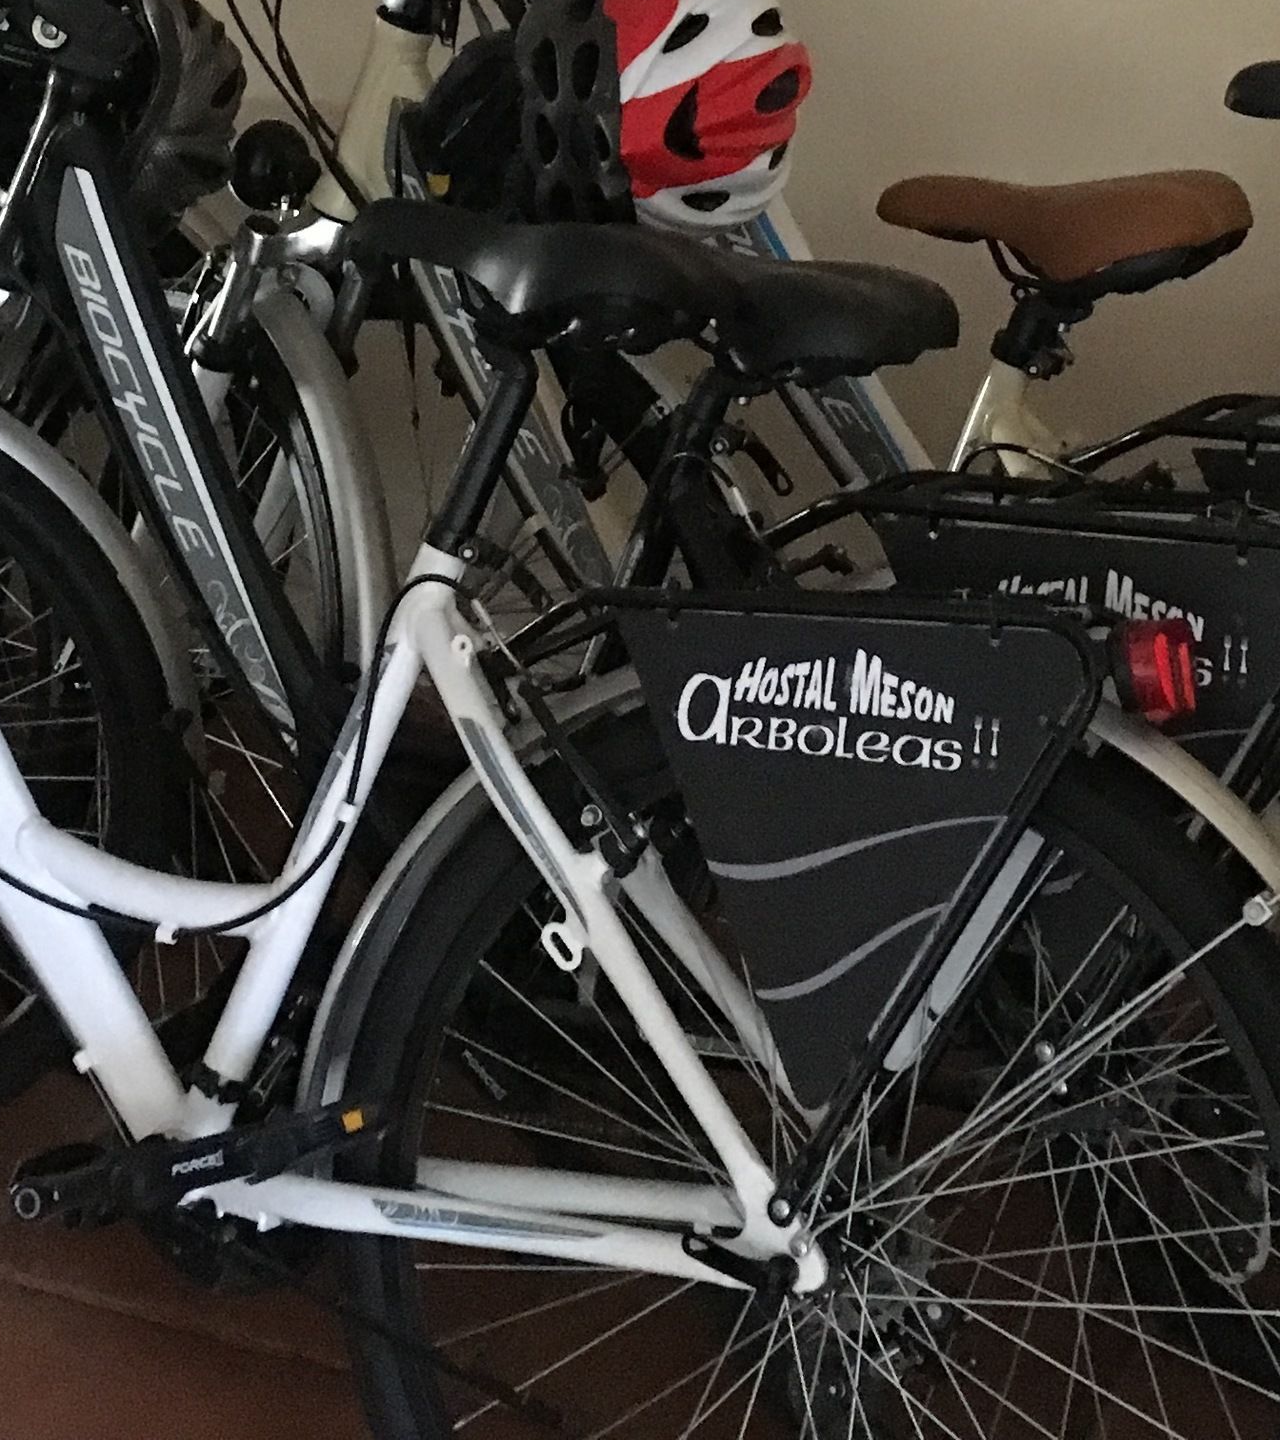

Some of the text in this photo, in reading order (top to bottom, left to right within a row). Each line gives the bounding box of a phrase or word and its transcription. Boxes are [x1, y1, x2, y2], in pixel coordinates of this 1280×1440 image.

[63, 242, 215, 558] BIOCYCLE
[734, 648, 954, 724] HOSTAL MESON
